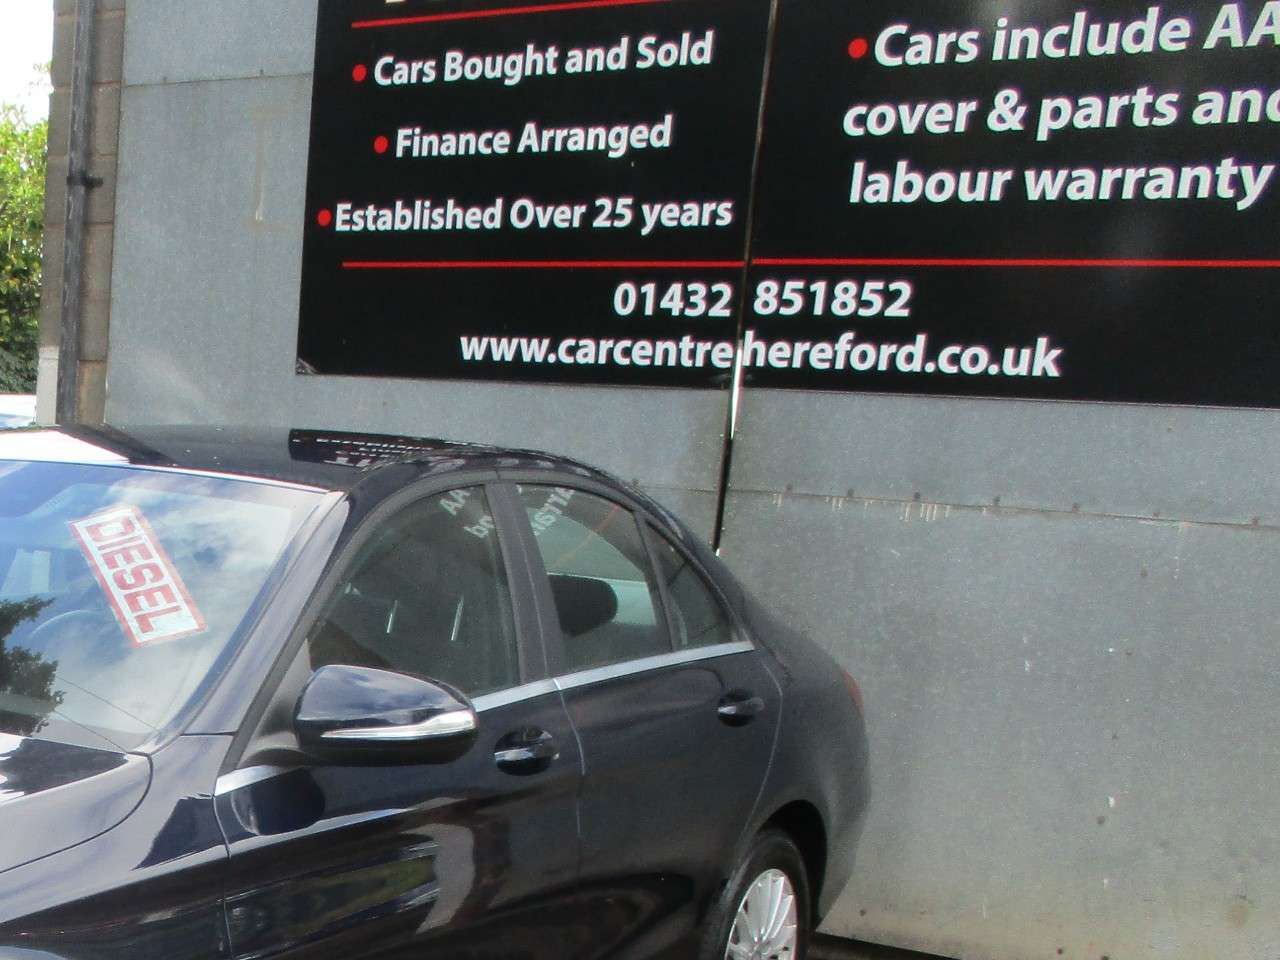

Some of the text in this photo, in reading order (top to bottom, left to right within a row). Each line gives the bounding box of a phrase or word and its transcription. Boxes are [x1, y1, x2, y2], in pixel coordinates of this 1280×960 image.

[374, 30, 714, 85] Cars Bought and Sold
[874, 0, 1280, 66] Cars include AA
[395, 115, 673, 158] Finance Arranged
[843, 101, 977, 137] cover
[986, 89, 1027, 131] &
[1036, 86, 1179, 141] parts
[849, 158, 1275, 210] labour warranty
[335, 198, 733, 236] Established Over 25 years
[613, 280, 912, 317] 01432 851852
[459, 330, 1063, 377] www.carcentrehereford.co.uk
[85, 516, 182, 634] DIESEL
